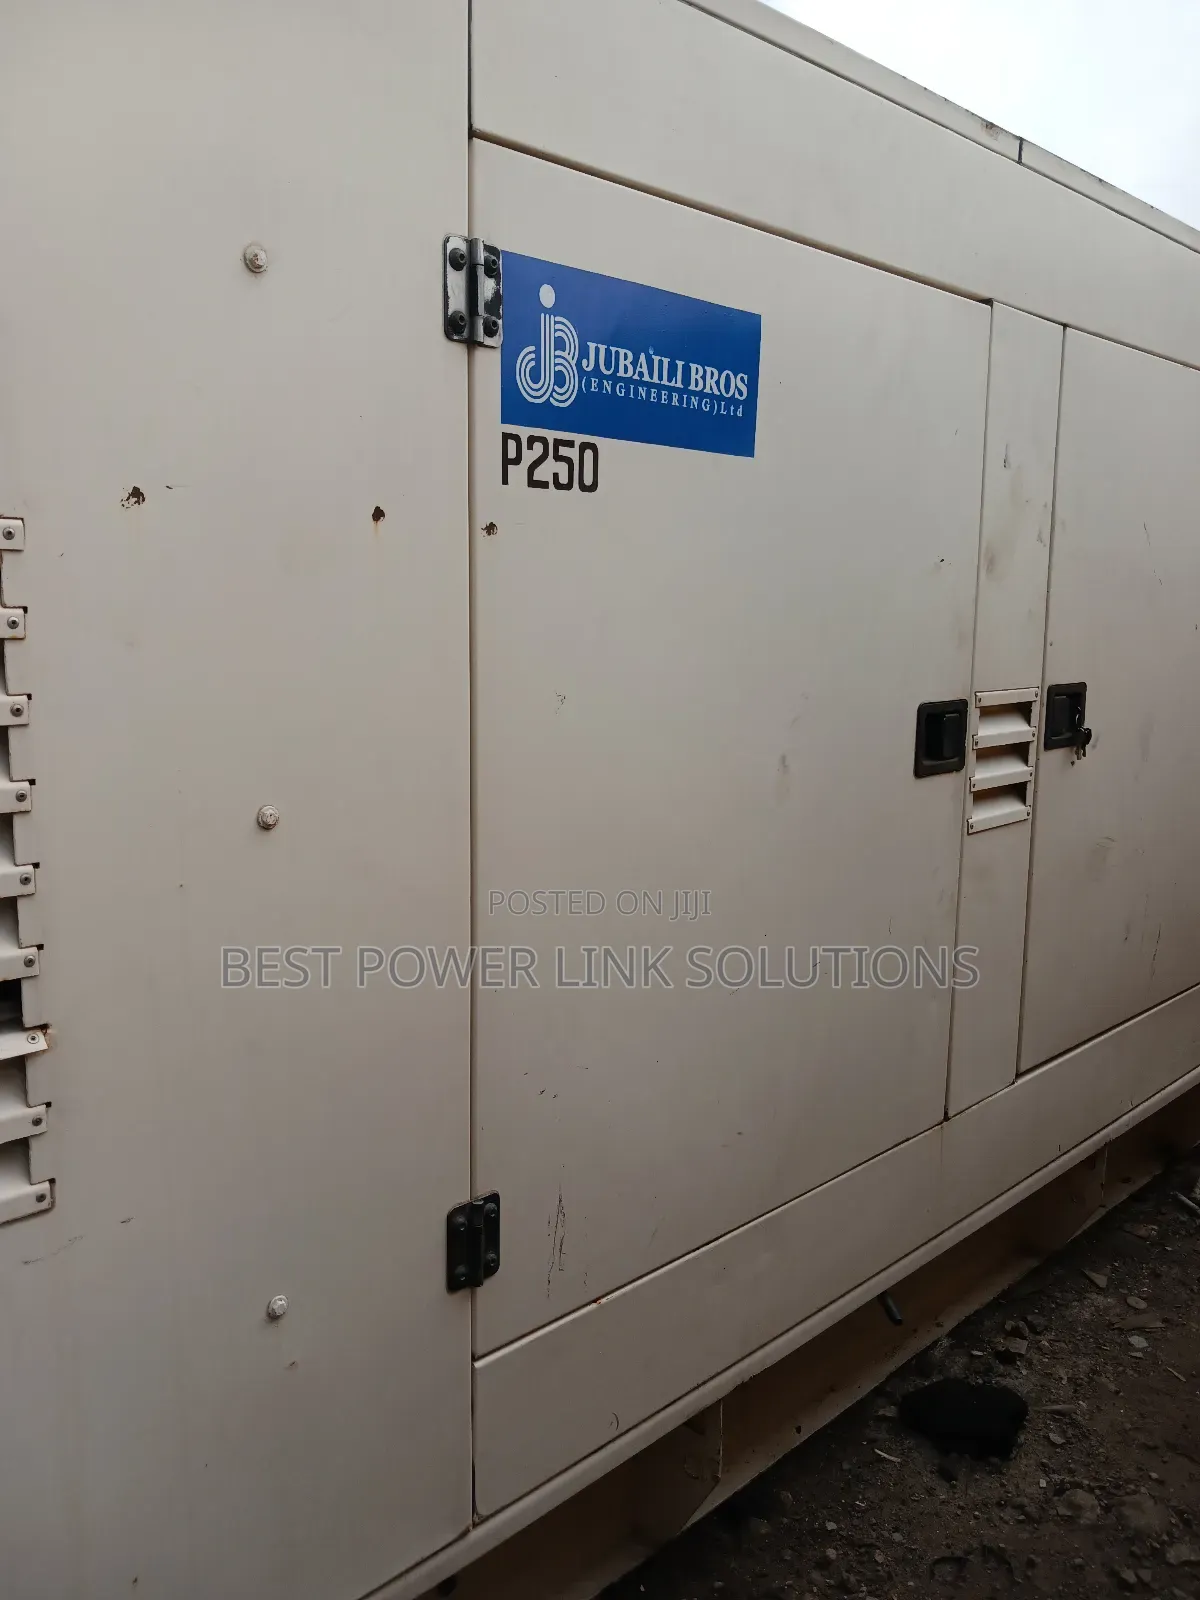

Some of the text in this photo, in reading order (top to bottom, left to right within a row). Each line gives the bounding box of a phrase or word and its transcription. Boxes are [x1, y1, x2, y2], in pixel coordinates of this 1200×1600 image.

[581, 341, 748, 400] JUBAILI BROS
[501, 431, 599, 493] P250
